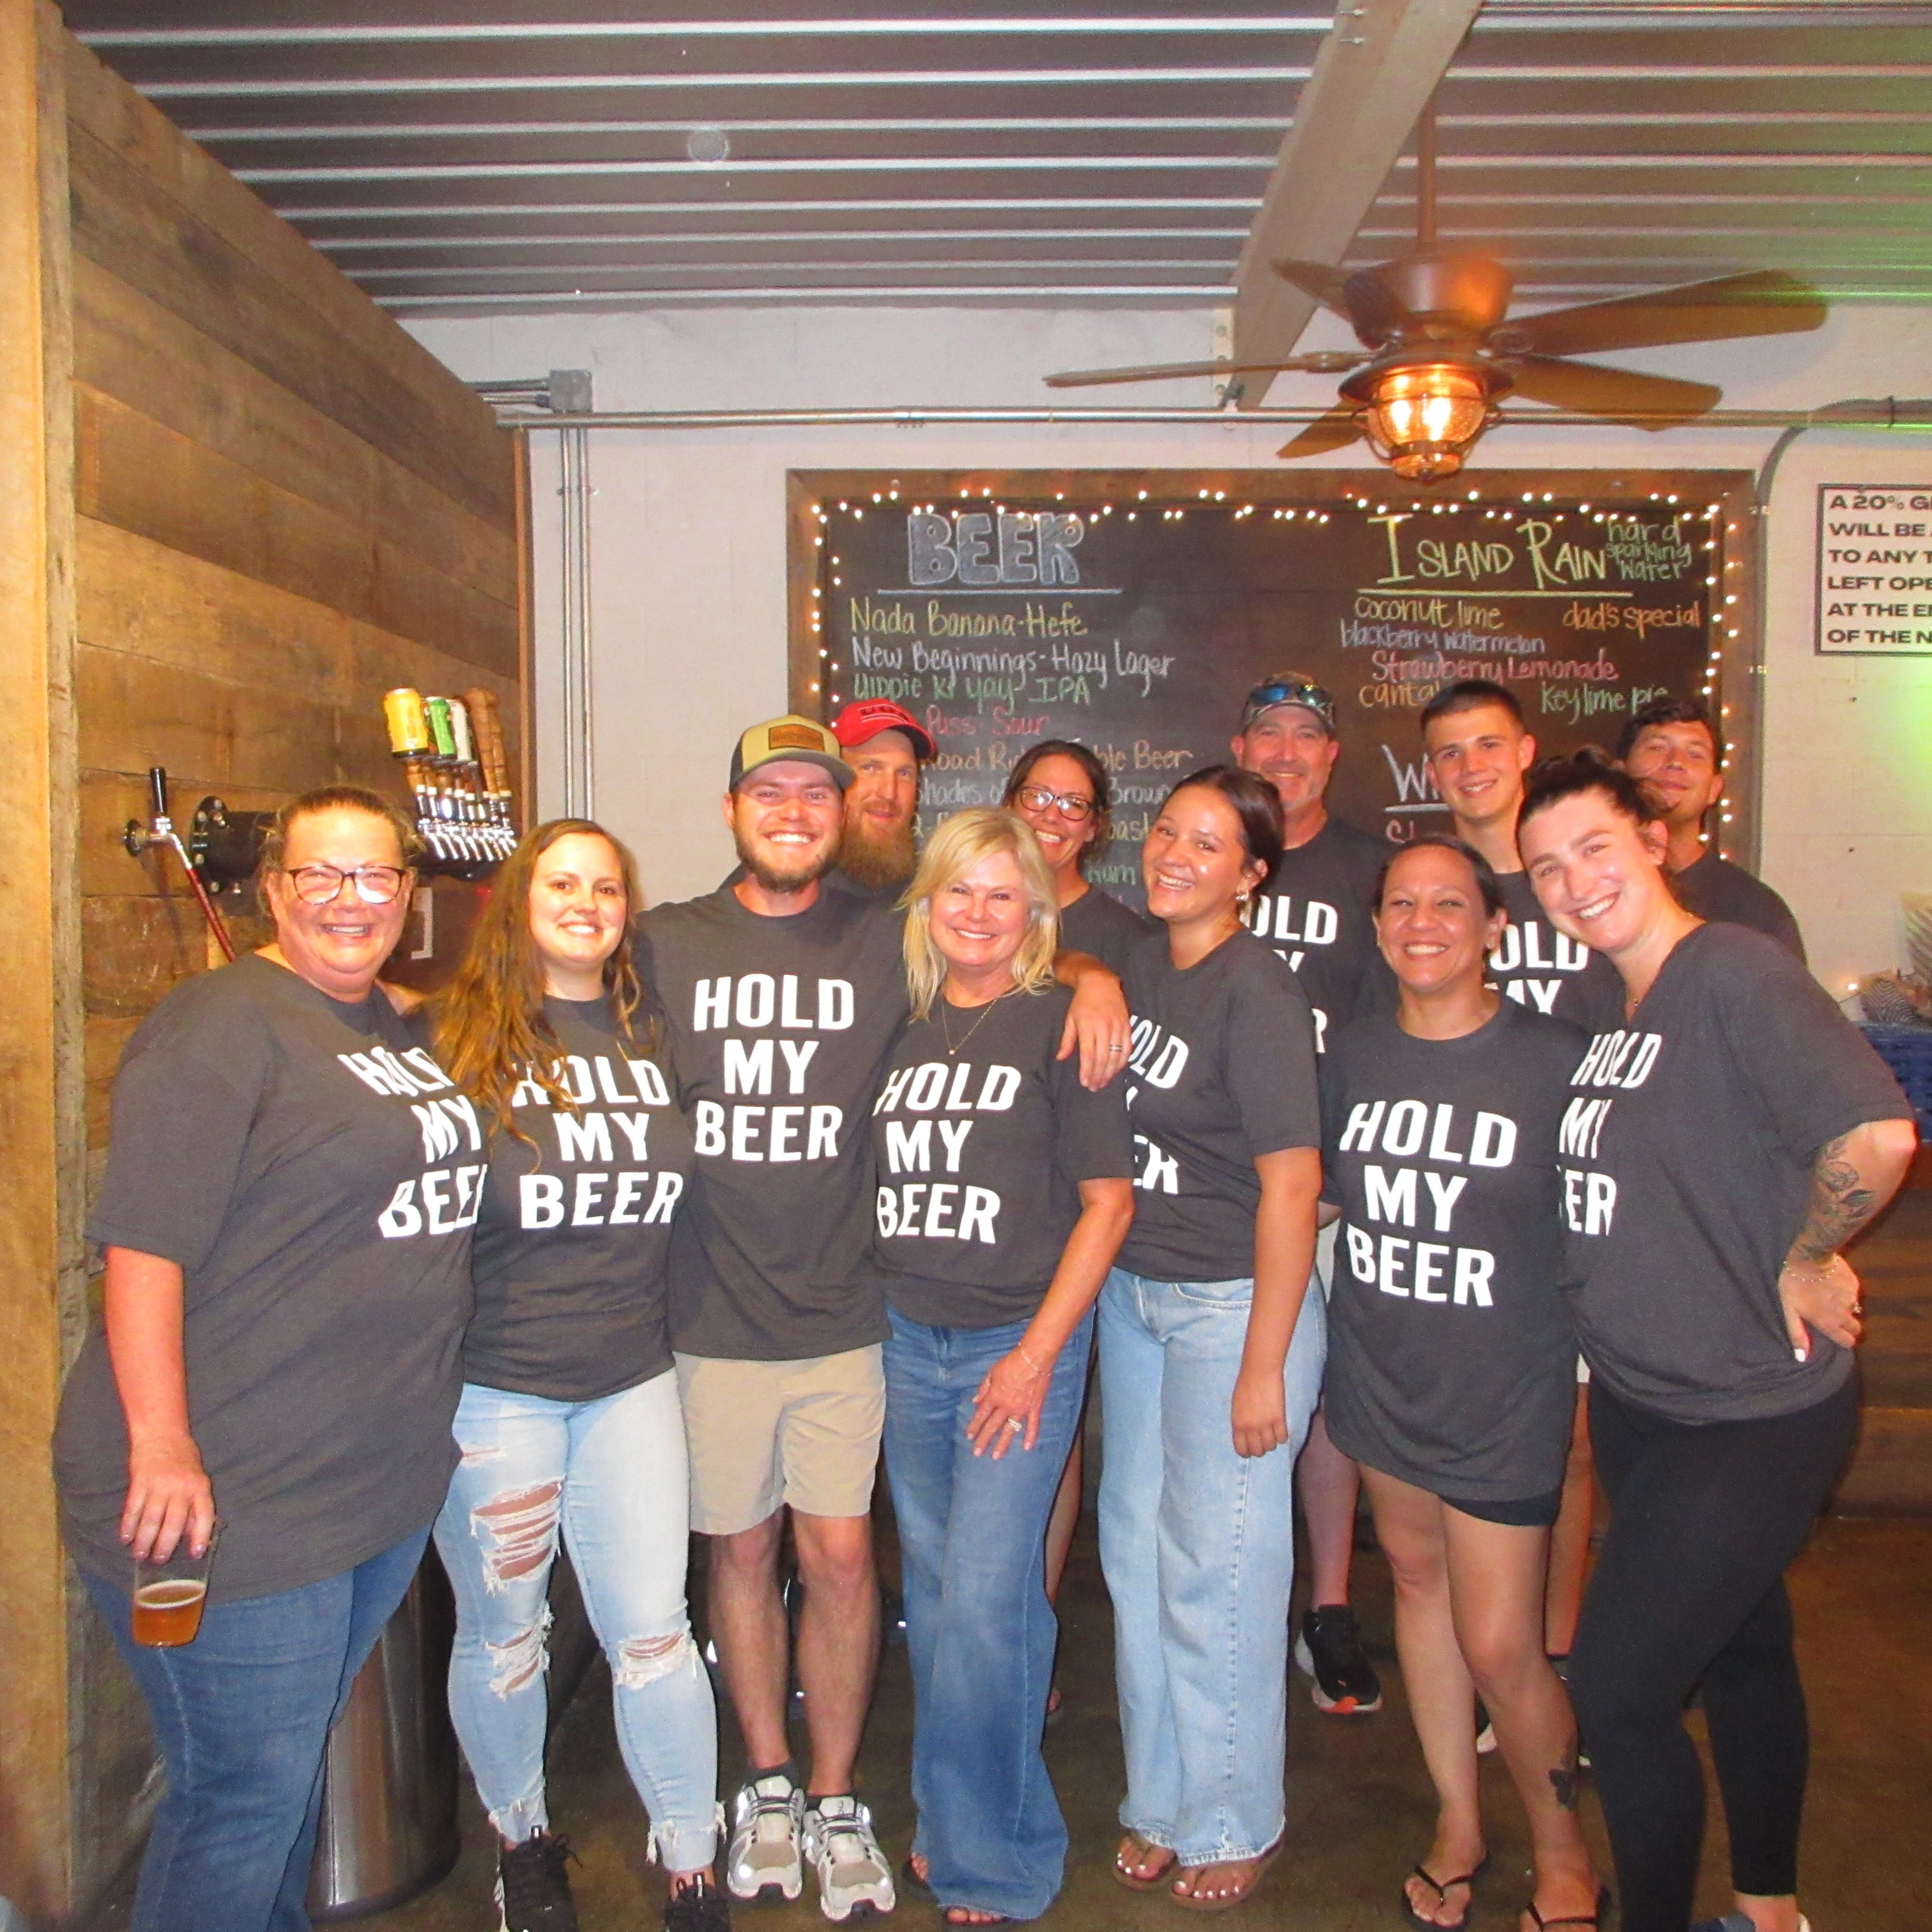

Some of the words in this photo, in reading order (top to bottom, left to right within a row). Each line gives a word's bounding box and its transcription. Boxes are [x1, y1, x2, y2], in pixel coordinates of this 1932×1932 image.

[1829, 523, 1889, 536] WILL
[1895, 523, 1925, 536] BE
[1830, 495, 1847, 509] A
[1853, 495, 1904, 510] 20%
[908, 512, 1084, 586] BEER
[1828, 550, 1861, 563] TO
[1866, 550, 1918, 563] ANY
[1828, 576, 1884, 590] LEFT
[1890, 577, 1932, 591] OPE
[1828, 603, 1858, 616] AT
[1862, 603, 1908, 616] THE
[851, 596, 916, 635] Nada
[1457, 600, 1505, 630] lime
[1828, 630, 1860, 643] OF
[1865, 630, 1911, 643] THE
[852, 636, 903, 667] New
[1051, 643, 1108, 690] Hazy
[1028, 675, 1091, 704] IPA
[920, 747, 982, 771] oad
[1135, 740, 1194, 770] Beer
[920, 777, 983, 805] hades
[1240, 894, 1339, 944] OLD
[1490, 921, 1589, 971] OLD
[693, 973, 854, 1032] HOLD
[724, 1039, 820, 1095] MY
[1128, 1015, 1189, 1089] OLD
[1570, 1029, 1663, 1089] HOLD
[872, 1062, 1022, 1116] HOLD
[410, 1095, 481, 1163] MY
[552, 1112, 650, 1162] MY
[694, 1099, 843, 1162] BEER
[886, 1119, 974, 1173] MY
[1339, 1099, 1517, 1167] HOLD
[1558, 1097, 1614, 1159] MY
[519, 1172, 684, 1229] BEER
[876, 1183, 1001, 1244] BEER
[1365, 1165, 1468, 1232] MY
[1562, 1164, 1617, 1237] ER
[1347, 1223, 1495, 1307] BEER
